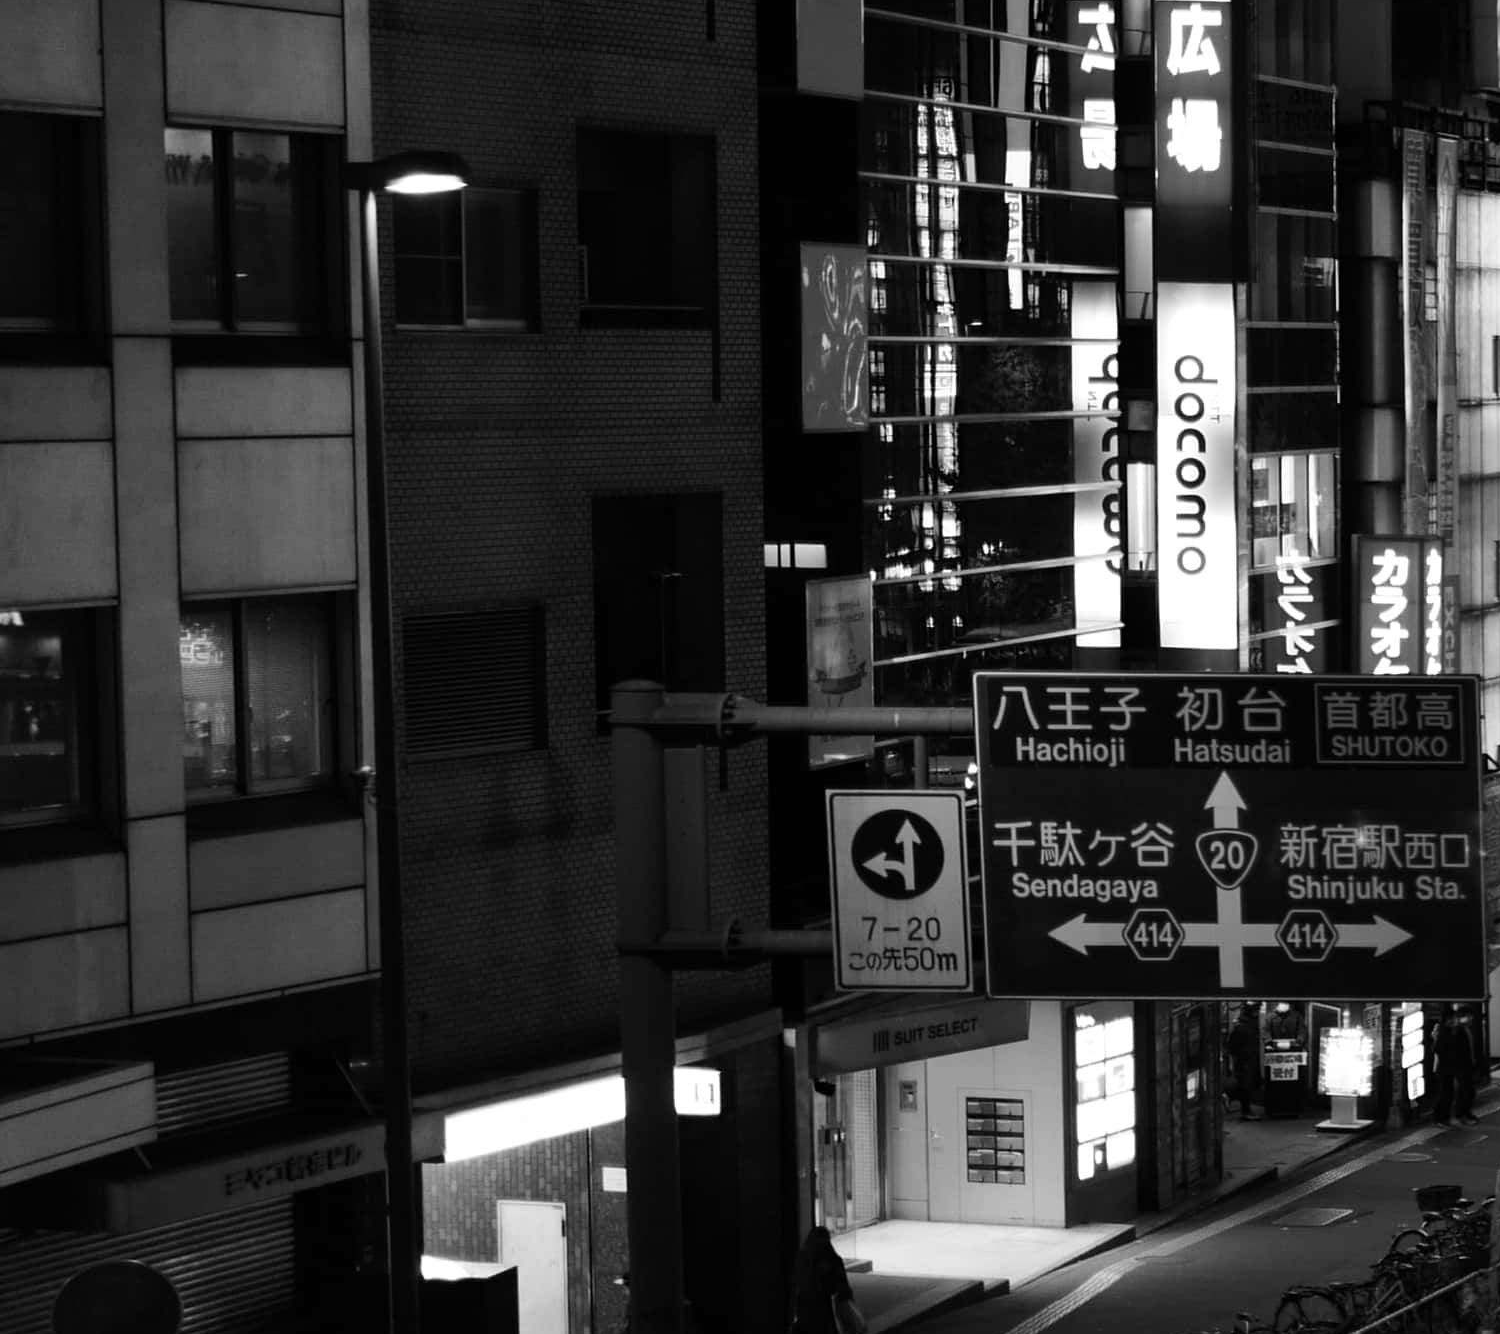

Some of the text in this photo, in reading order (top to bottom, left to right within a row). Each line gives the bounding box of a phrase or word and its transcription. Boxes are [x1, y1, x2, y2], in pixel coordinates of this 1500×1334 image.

[1174, 355, 1218, 575] docomo
[993, 684, 1288, 734] 八王子 初台
[1322, 691, 1454, 730] 首都高
[1015, 736, 1291, 767] Hachioji Hatsudai
[1331, 735, 1449, 757] SHUTOKO
[1209, 839, 1245, 871] 20
[1279, 823, 1470, 871] 新宿駅西口
[1012, 873, 1467, 904] Sendagaya Shinjuku Sta.
[1134, 922, 1173, 949] 414
[1286, 923, 1328, 950] 414
[894, 1018, 977, 1045] SUIT SELECT
